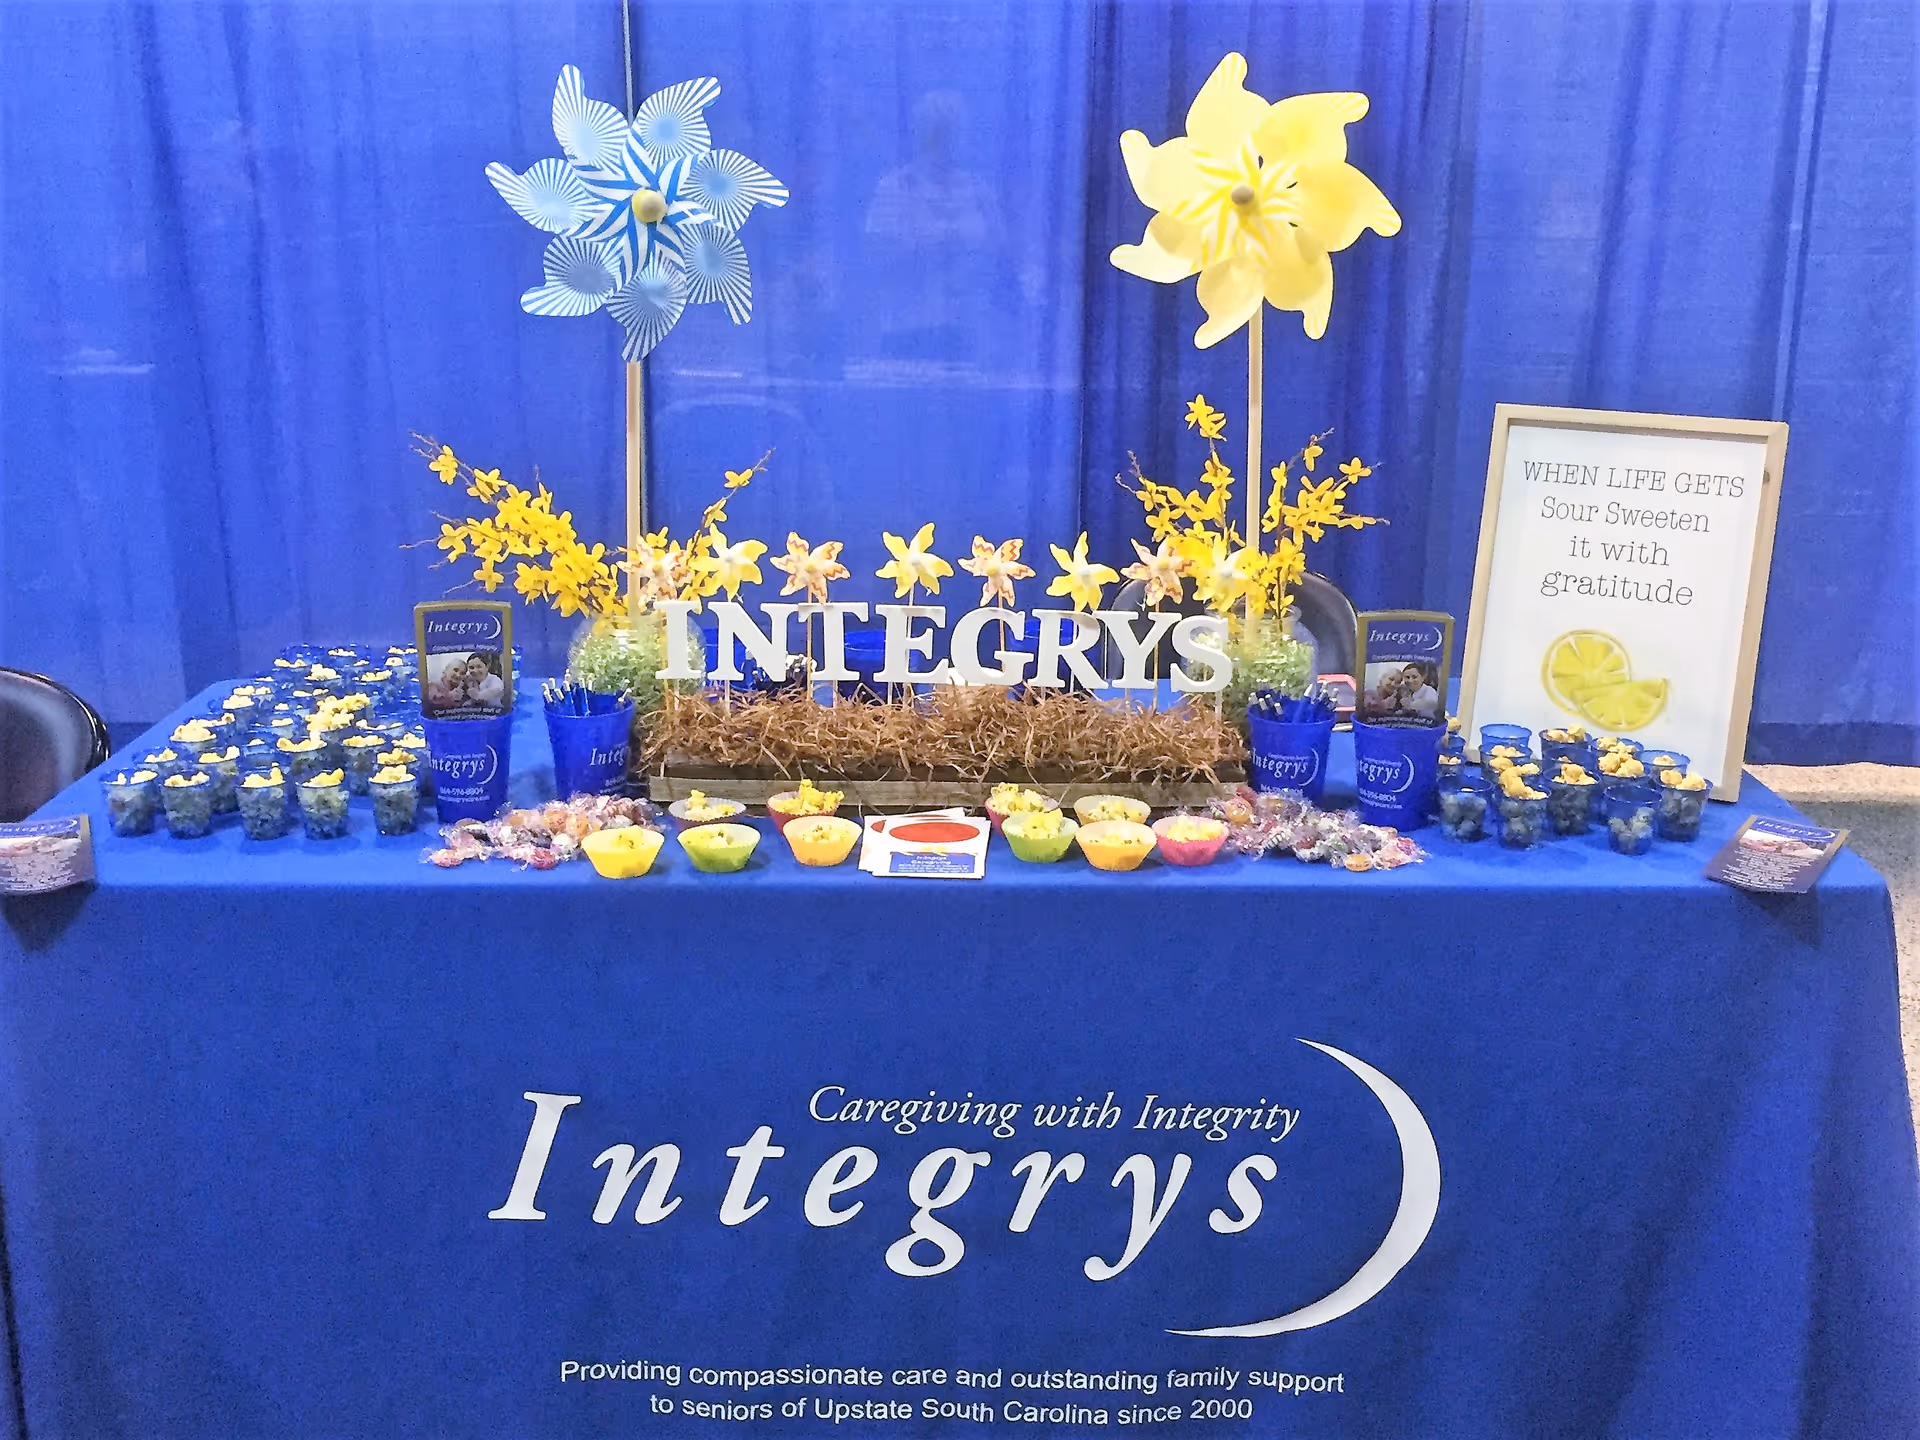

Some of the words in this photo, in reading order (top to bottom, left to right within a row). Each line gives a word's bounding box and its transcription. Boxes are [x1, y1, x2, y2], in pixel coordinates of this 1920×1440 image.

[1523, 460, 1600, 486] WHEN
[1606, 467, 1666, 492] LIFE
[1674, 472, 1745, 498] GETS
[1541, 496, 1599, 523] Sour
[1605, 501, 1711, 533] Sweeten
[1569, 536, 1591, 559] it
[1601, 541, 1670, 567] with
[1540, 571, 1693, 606] gratitude
[428, 620, 489, 635] Integrys
[1369, 629, 1430, 645] Integrys
[655, 600, 1232, 693] INTEGRYS
[1252, 747, 1308, 780] Integrys
[809, 1085, 1022, 1138] Caregiving
[1033, 1091, 1122, 1129] with
[1133, 1095, 1300, 1143] Integrity
[488, 1090, 1279, 1282] Integrys
[560, 1360, 681, 1386] Providing
[689, 1365, 883, 1391] compassionate
[891, 1368, 948, 1386] care
[955, 1368, 1002, 1389] and
[1010, 1369, 1158, 1395] outstanding
[1166, 1367, 1240, 1391] family
[1247, 1371, 1345, 1396] support
[649, 1394, 674, 1414] to
[682, 1399, 773, 1421] seniors
[781, 1397, 808, 1418] of
[815, 1398, 913, 1425] Upstate
[921, 1398, 994, 1423] South
[1003, 1400, 1108, 1425] Carolina
[1117, 1402, 1182, 1425] since
[1190, 1398, 1253, 1419] 2000
